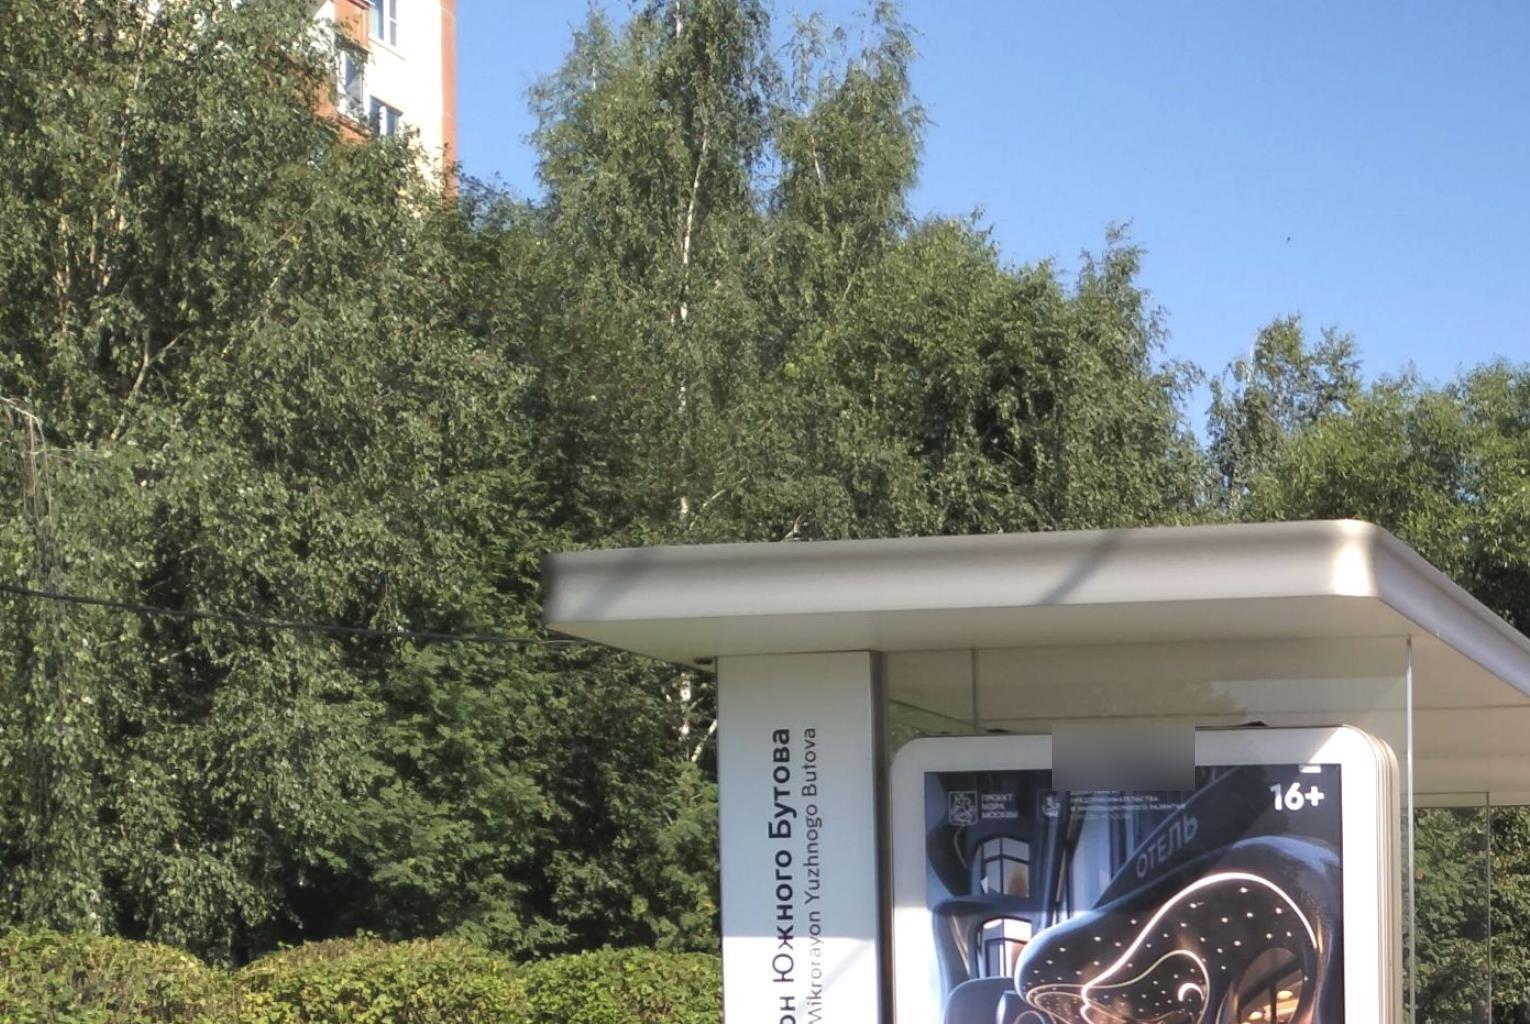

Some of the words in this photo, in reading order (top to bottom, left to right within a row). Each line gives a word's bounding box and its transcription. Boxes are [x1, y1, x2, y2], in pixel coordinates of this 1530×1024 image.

[768, 728, 798, 839] Бутова
[801, 727, 818, 797] Butova
[1269, 782, 1325, 811] 16+
[803, 803, 823, 904] Yuzhnogo
[1136, 812, 1198, 878] ОТЕЛЬ
[771, 849, 796, 983] Южного
